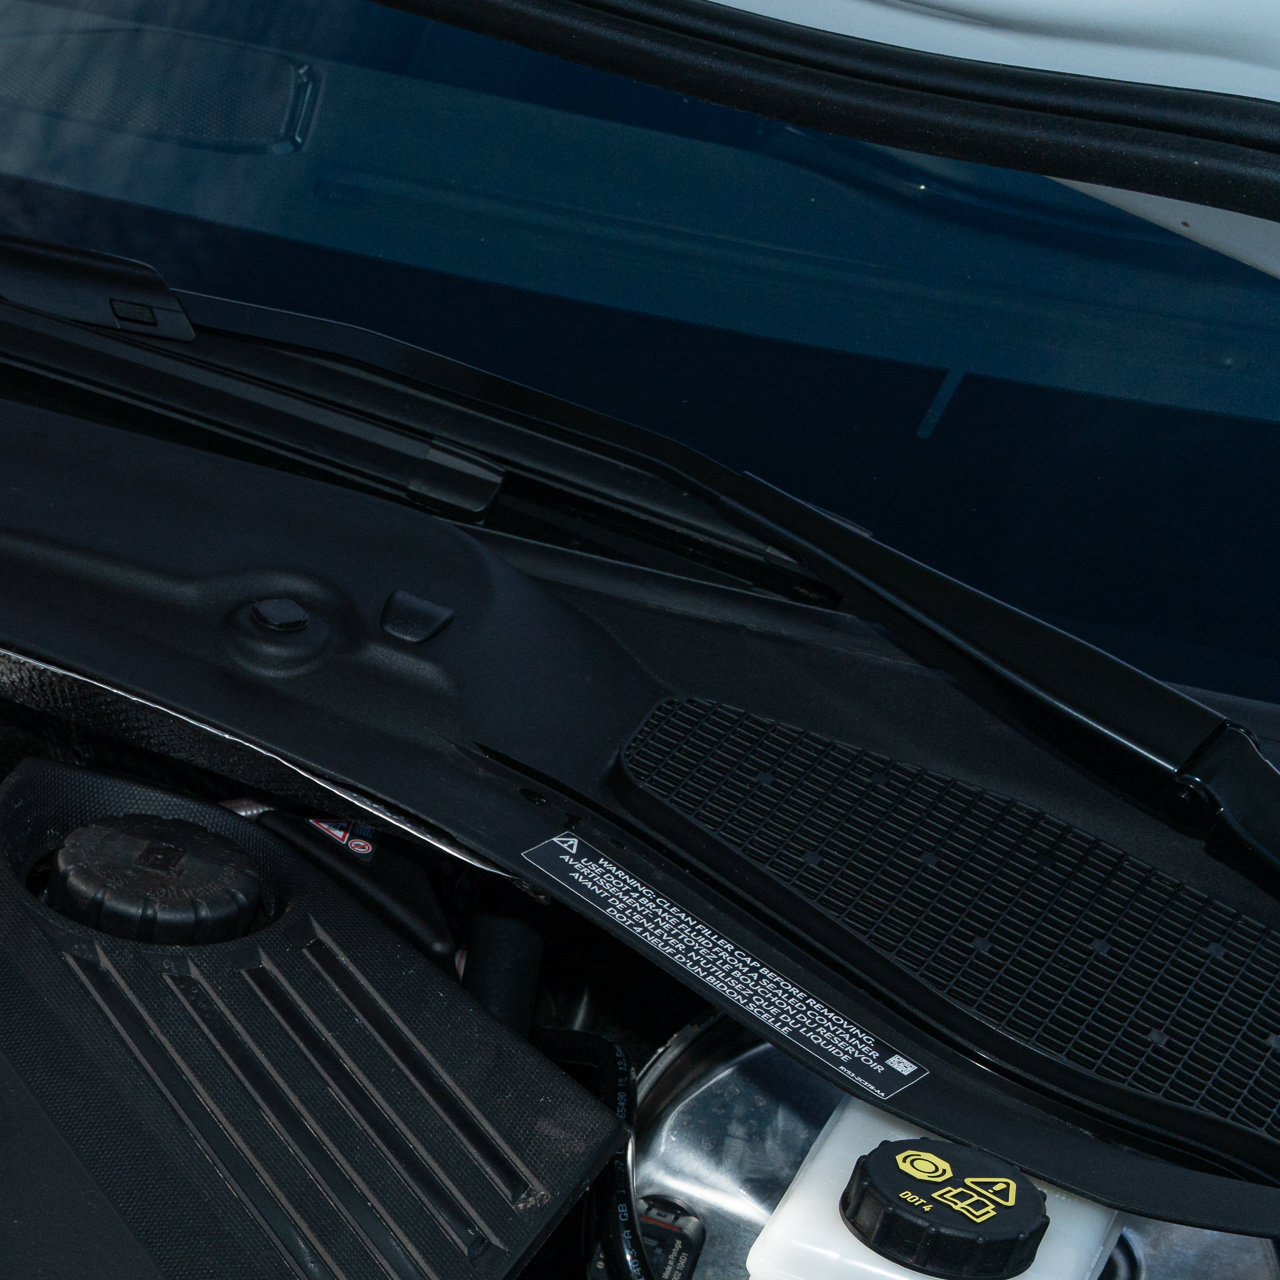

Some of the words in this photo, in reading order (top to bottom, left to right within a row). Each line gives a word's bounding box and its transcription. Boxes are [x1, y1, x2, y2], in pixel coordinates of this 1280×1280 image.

[559, 855, 653, 917] AVERTISSEMENT-
[653, 917, 717, 960] NETTOYEZ
[715, 959, 732, 971] LE
[730, 970, 796, 1014] BOUCHON
[795, 1013, 817, 1027] DU
[815, 1026, 884, 1072] RESERVOIR
[568, 872, 610, 897] AVANT
[607, 897, 626, 910] DE
[624, 908, 685, 952] L'ENLEVER.
[687, 951, 753, 996] N'UTILISEZ
[752, 995, 781, 1015] QUE
[779, 1013, 800, 1027] DU
[799, 1027, 852, 1062] LIQUIDE
[580, 857, 605, 874] USE
[602, 873, 631, 890] DOT
[637, 897, 679, 925] BRAKE
[677, 923, 712, 947] FLUID
[711, 946, 749, 972] FROM
[747, 972, 758, 980] A
[758, 978, 806, 1010] SEALED
[806, 1010, 879, 1059] CONTAINER
[598, 857, 655, 898] WARNING:
[655, 898, 696, 925] CLEAN
[694, 924, 734, 951] FILLER
[734, 950, 760, 967] CAP
[758, 967, 807, 999] BEFORE
[805, 998, 874, 1046] REMOVING.
[605, 907, 634, 925] DOT
[641, 931, 676, 953] NEUF
[673, 953, 707, 976] D'UN
[705, 975, 747, 1003] BIDON
[745, 1002, 792, 1034] SCELLE
[899, 1191, 927, 1205] DOT
